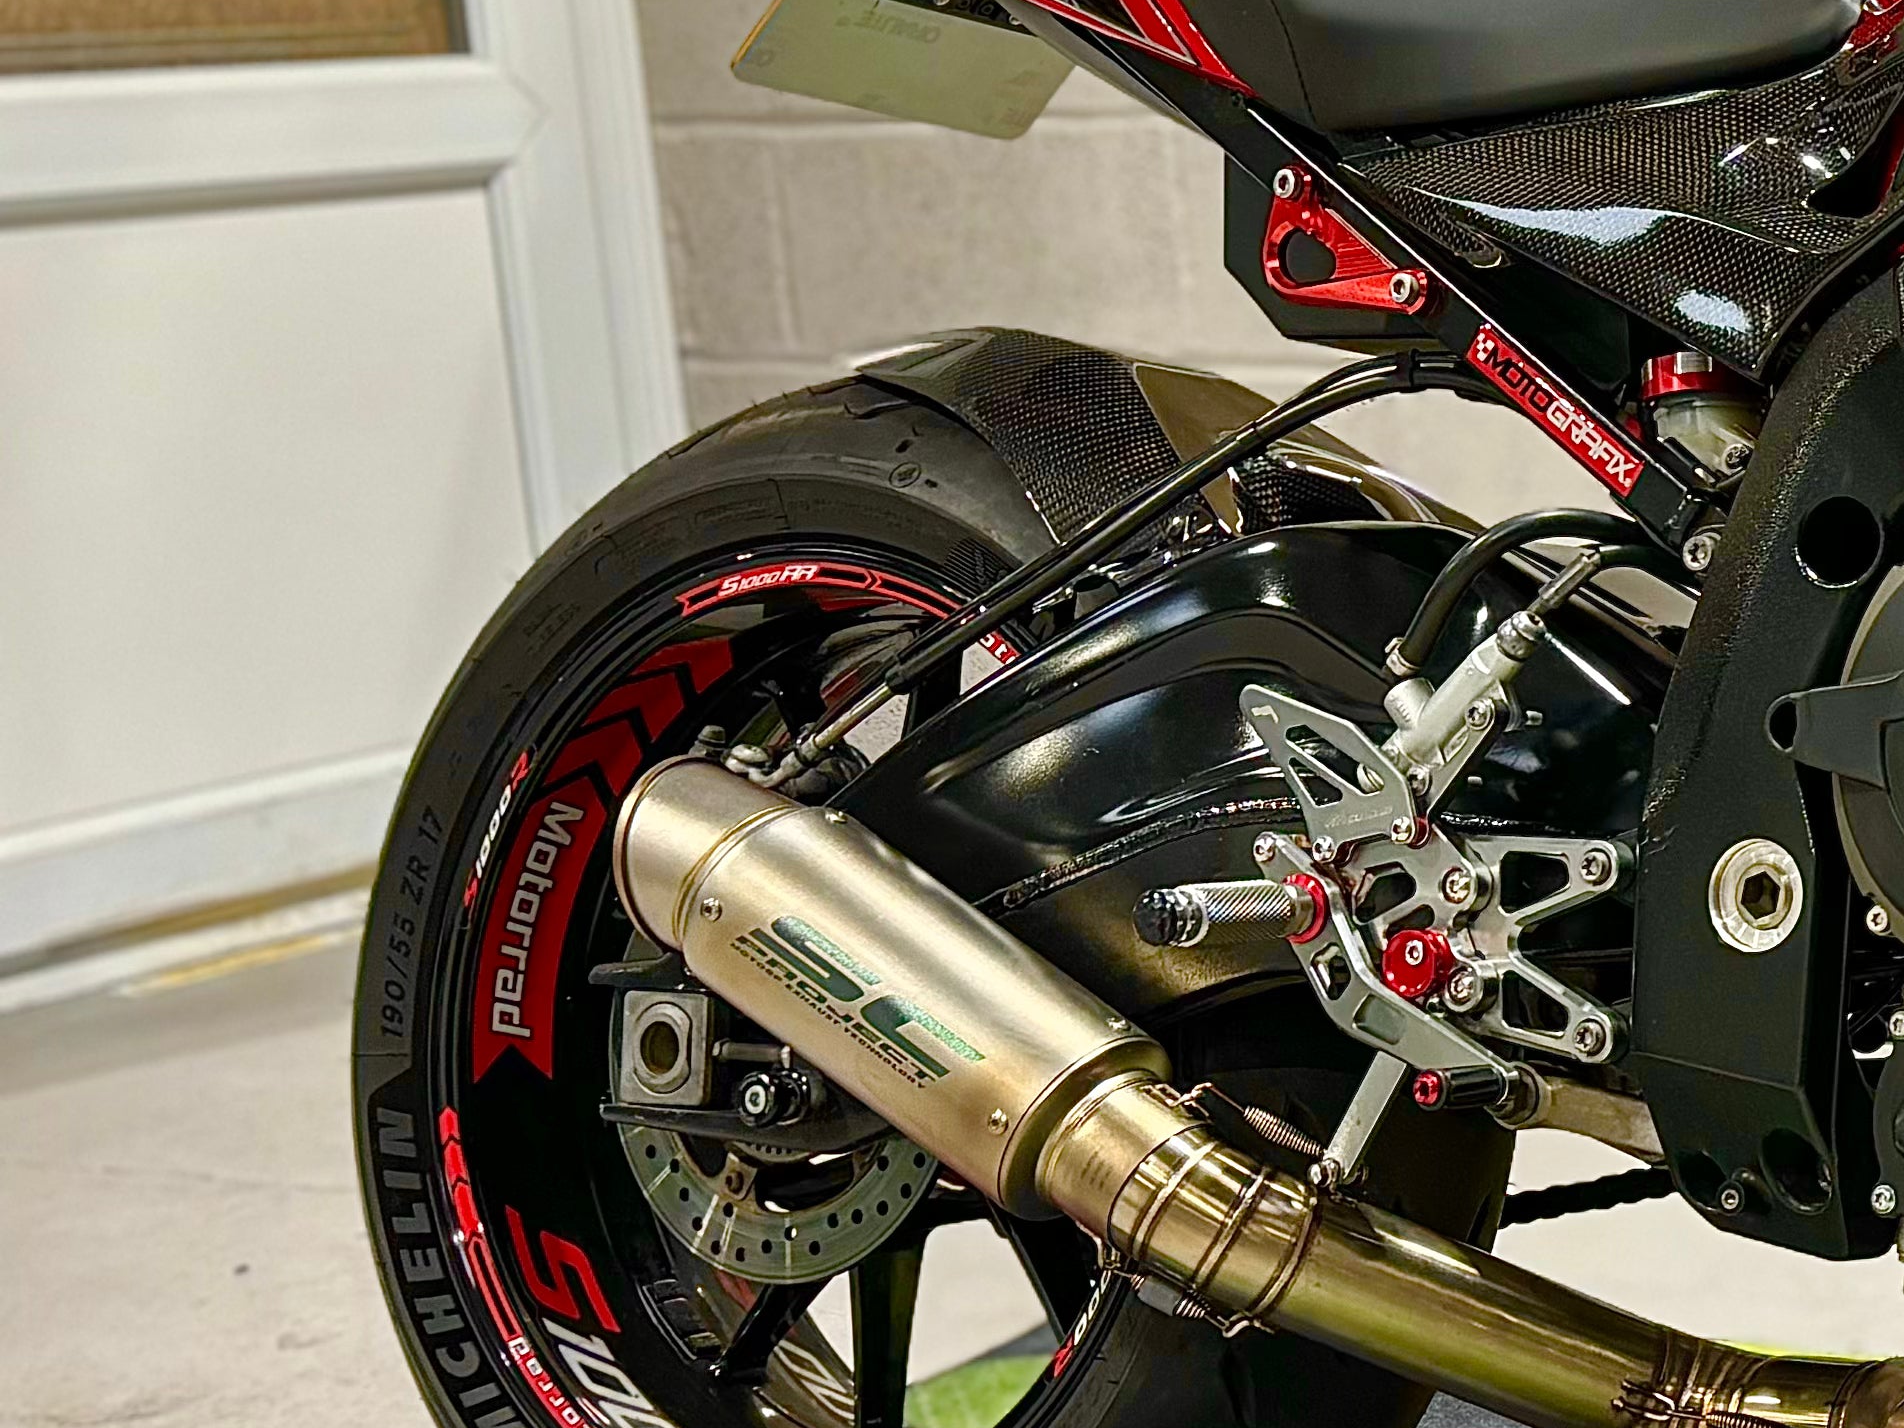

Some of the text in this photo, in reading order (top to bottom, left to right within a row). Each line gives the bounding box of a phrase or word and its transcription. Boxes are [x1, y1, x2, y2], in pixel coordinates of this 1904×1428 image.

[1483, 346, 1632, 487] MOTOGRAFIX
[720, 564, 819, 597] S1000RR
[491, 801, 584, 1039] Motorrad
[733, 936, 938, 1084] PROJECT
[745, 913, 986, 1079] SC
